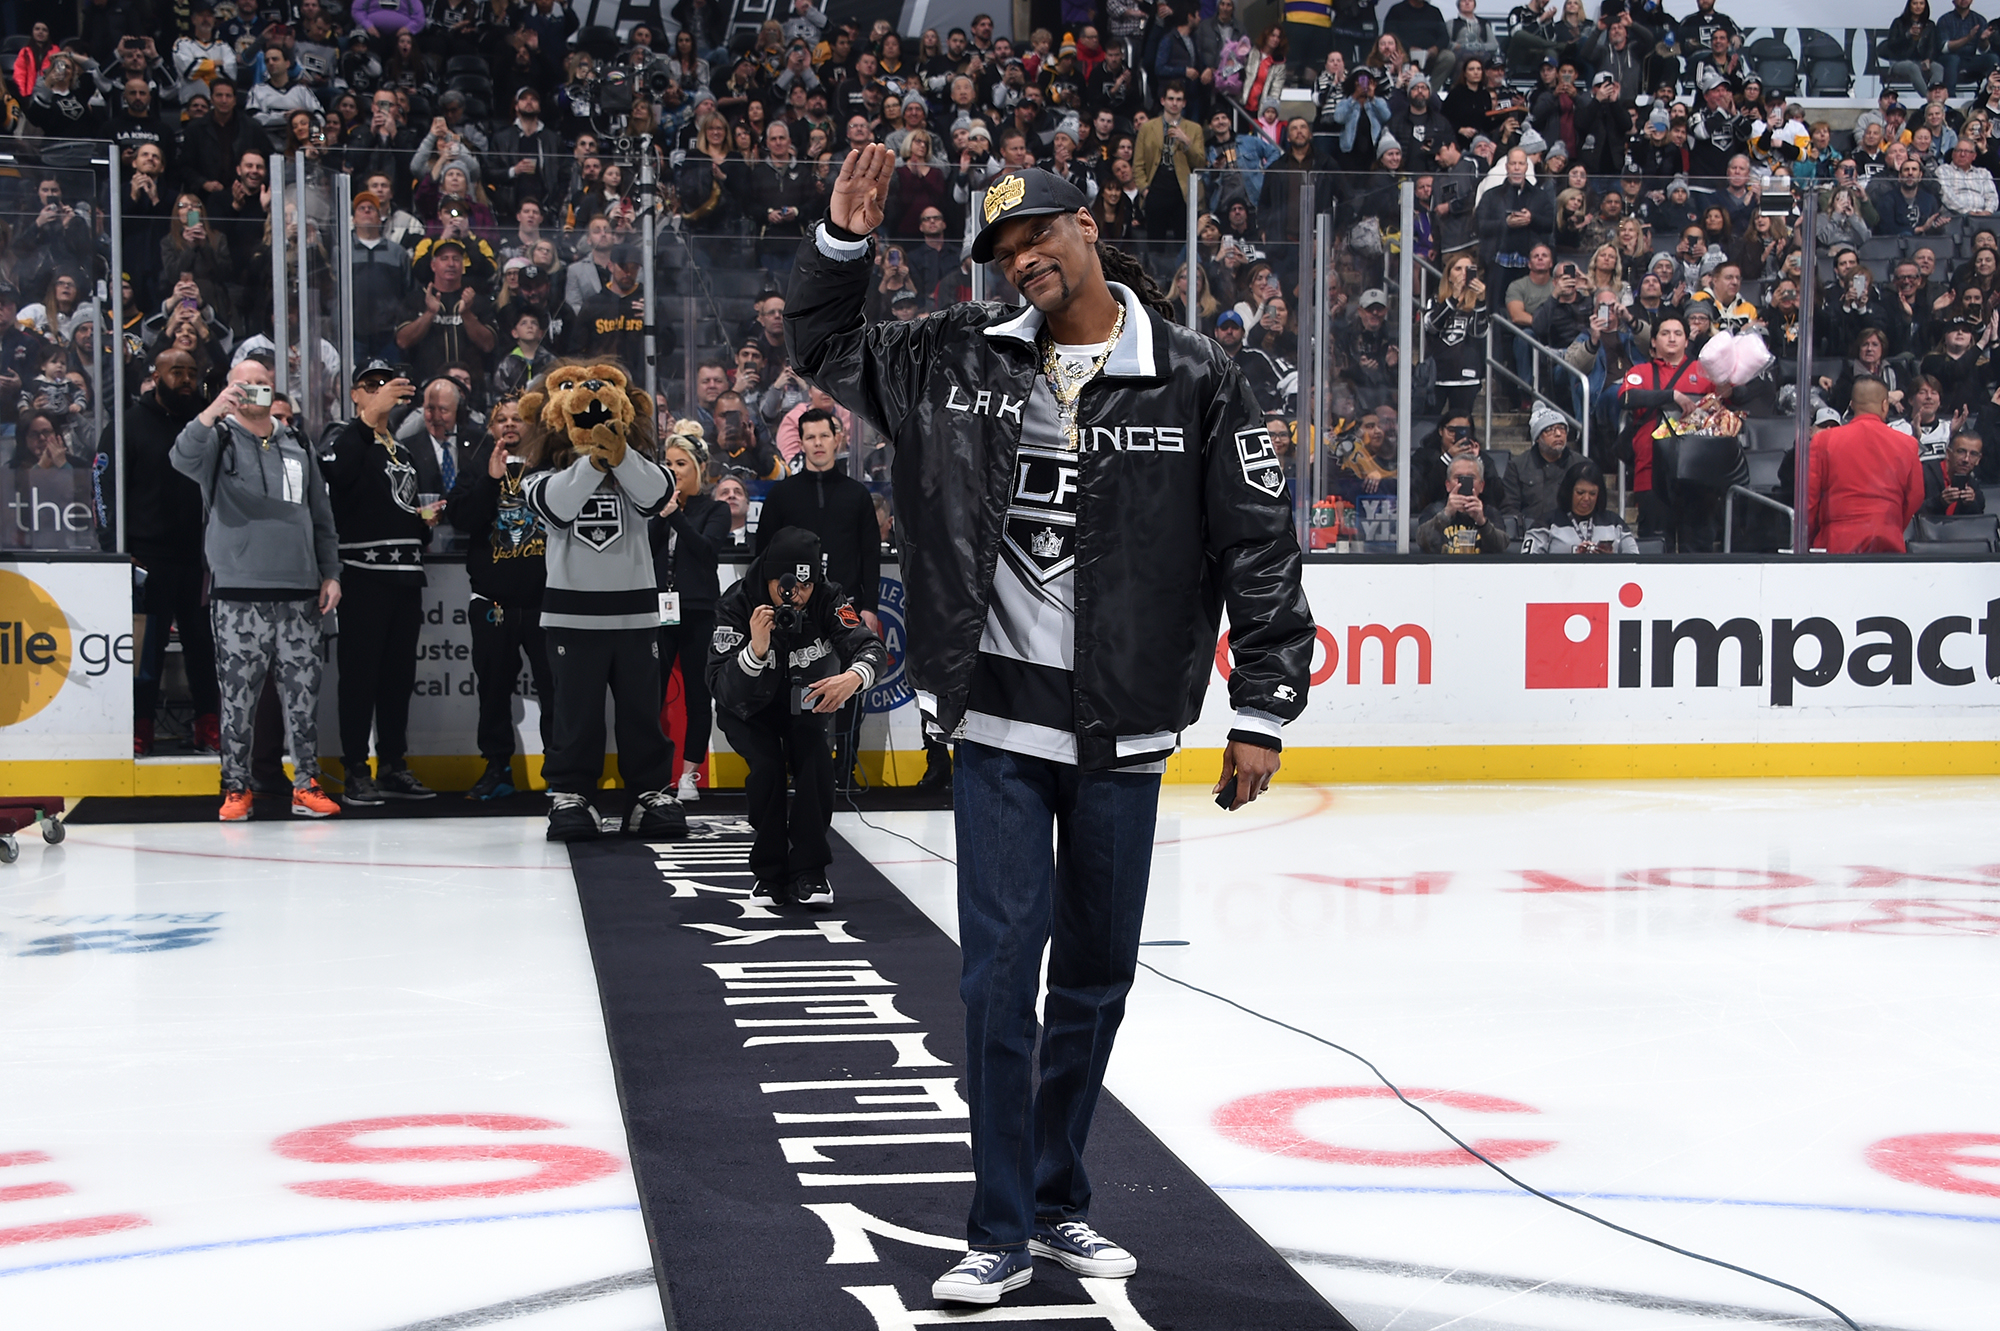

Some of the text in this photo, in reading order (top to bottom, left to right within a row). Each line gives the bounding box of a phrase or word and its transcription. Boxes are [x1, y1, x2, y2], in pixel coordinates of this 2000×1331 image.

[117, 131, 159, 142] LA KINGS
[1239, 434, 1278, 461] LA
[8, 486, 92, 532] the
[577, 500, 616, 519] LA
